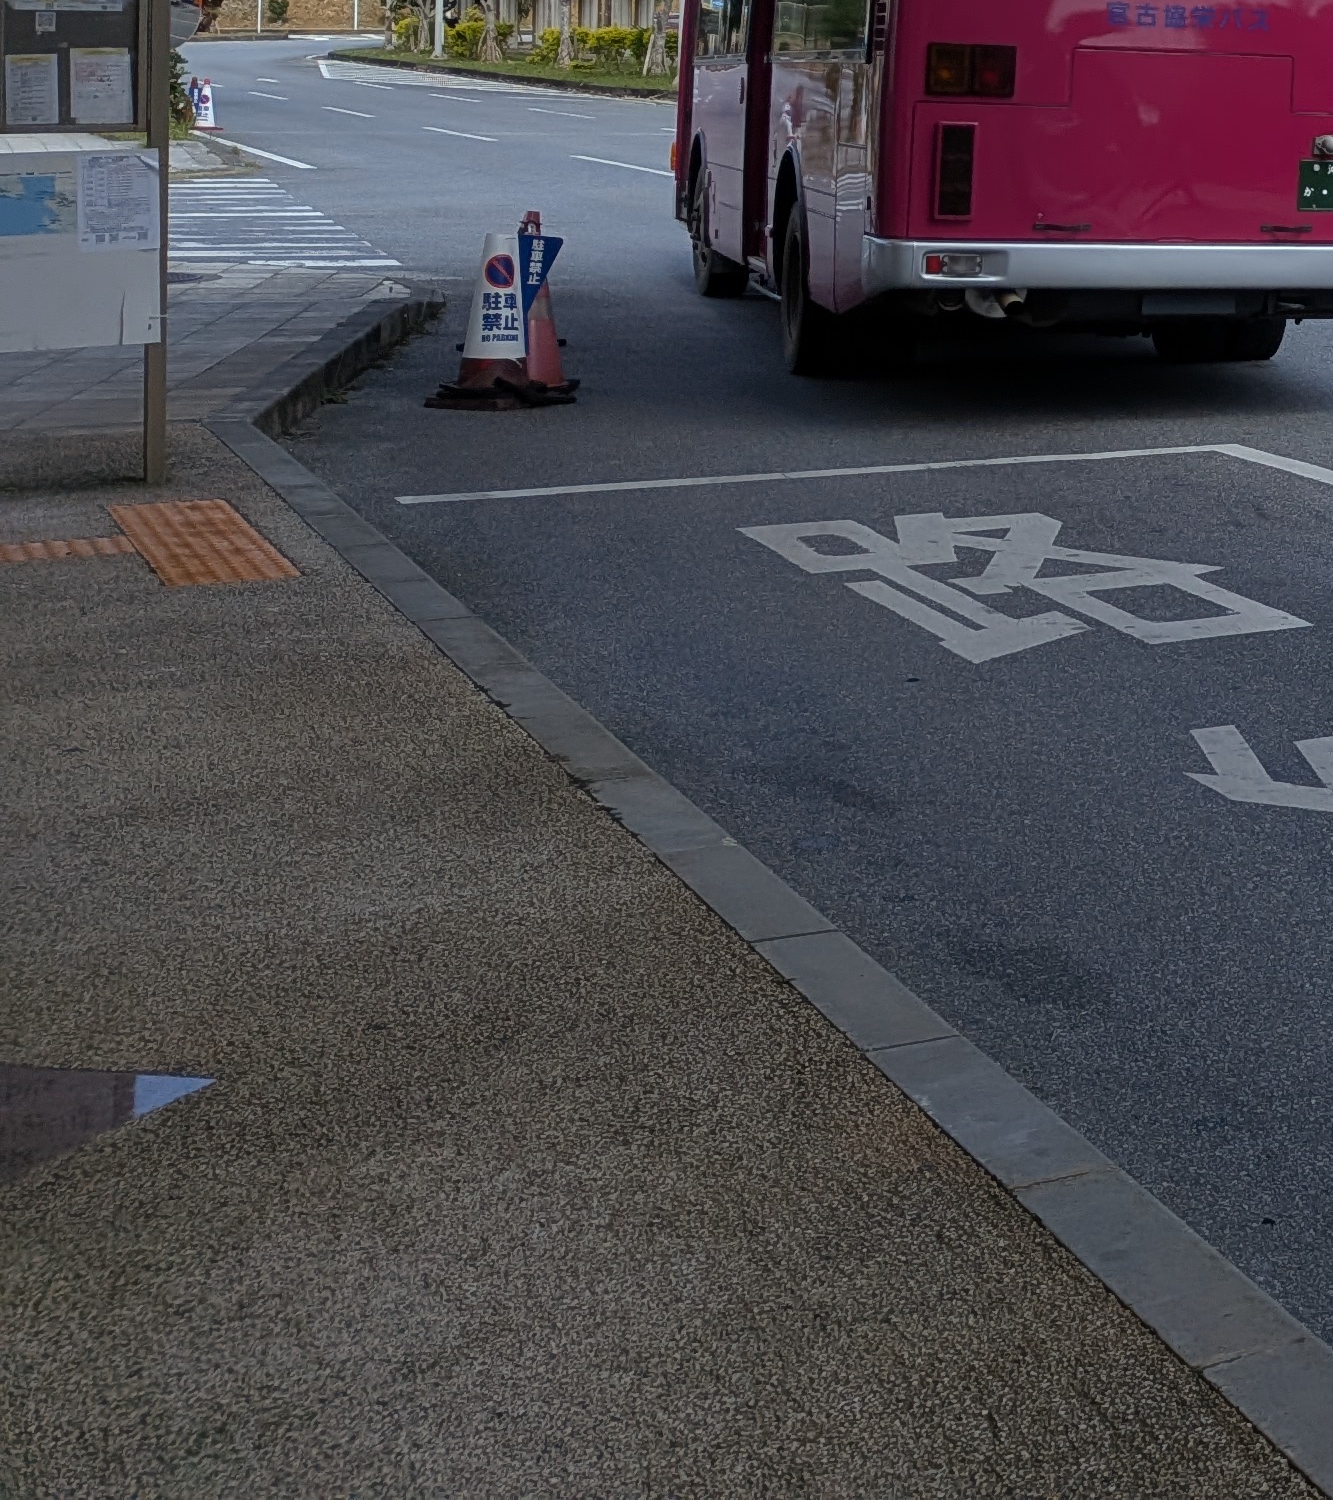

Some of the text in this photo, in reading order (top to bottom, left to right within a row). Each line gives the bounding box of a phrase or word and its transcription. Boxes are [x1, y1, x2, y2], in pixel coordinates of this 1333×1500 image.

[1106, 0, 1269, 32] 宮古協栄バス
[526, 239, 545, 285] 駐車禁止
[482, 292, 518, 311] 駐車
[482, 312, 519, 332] 禁止
